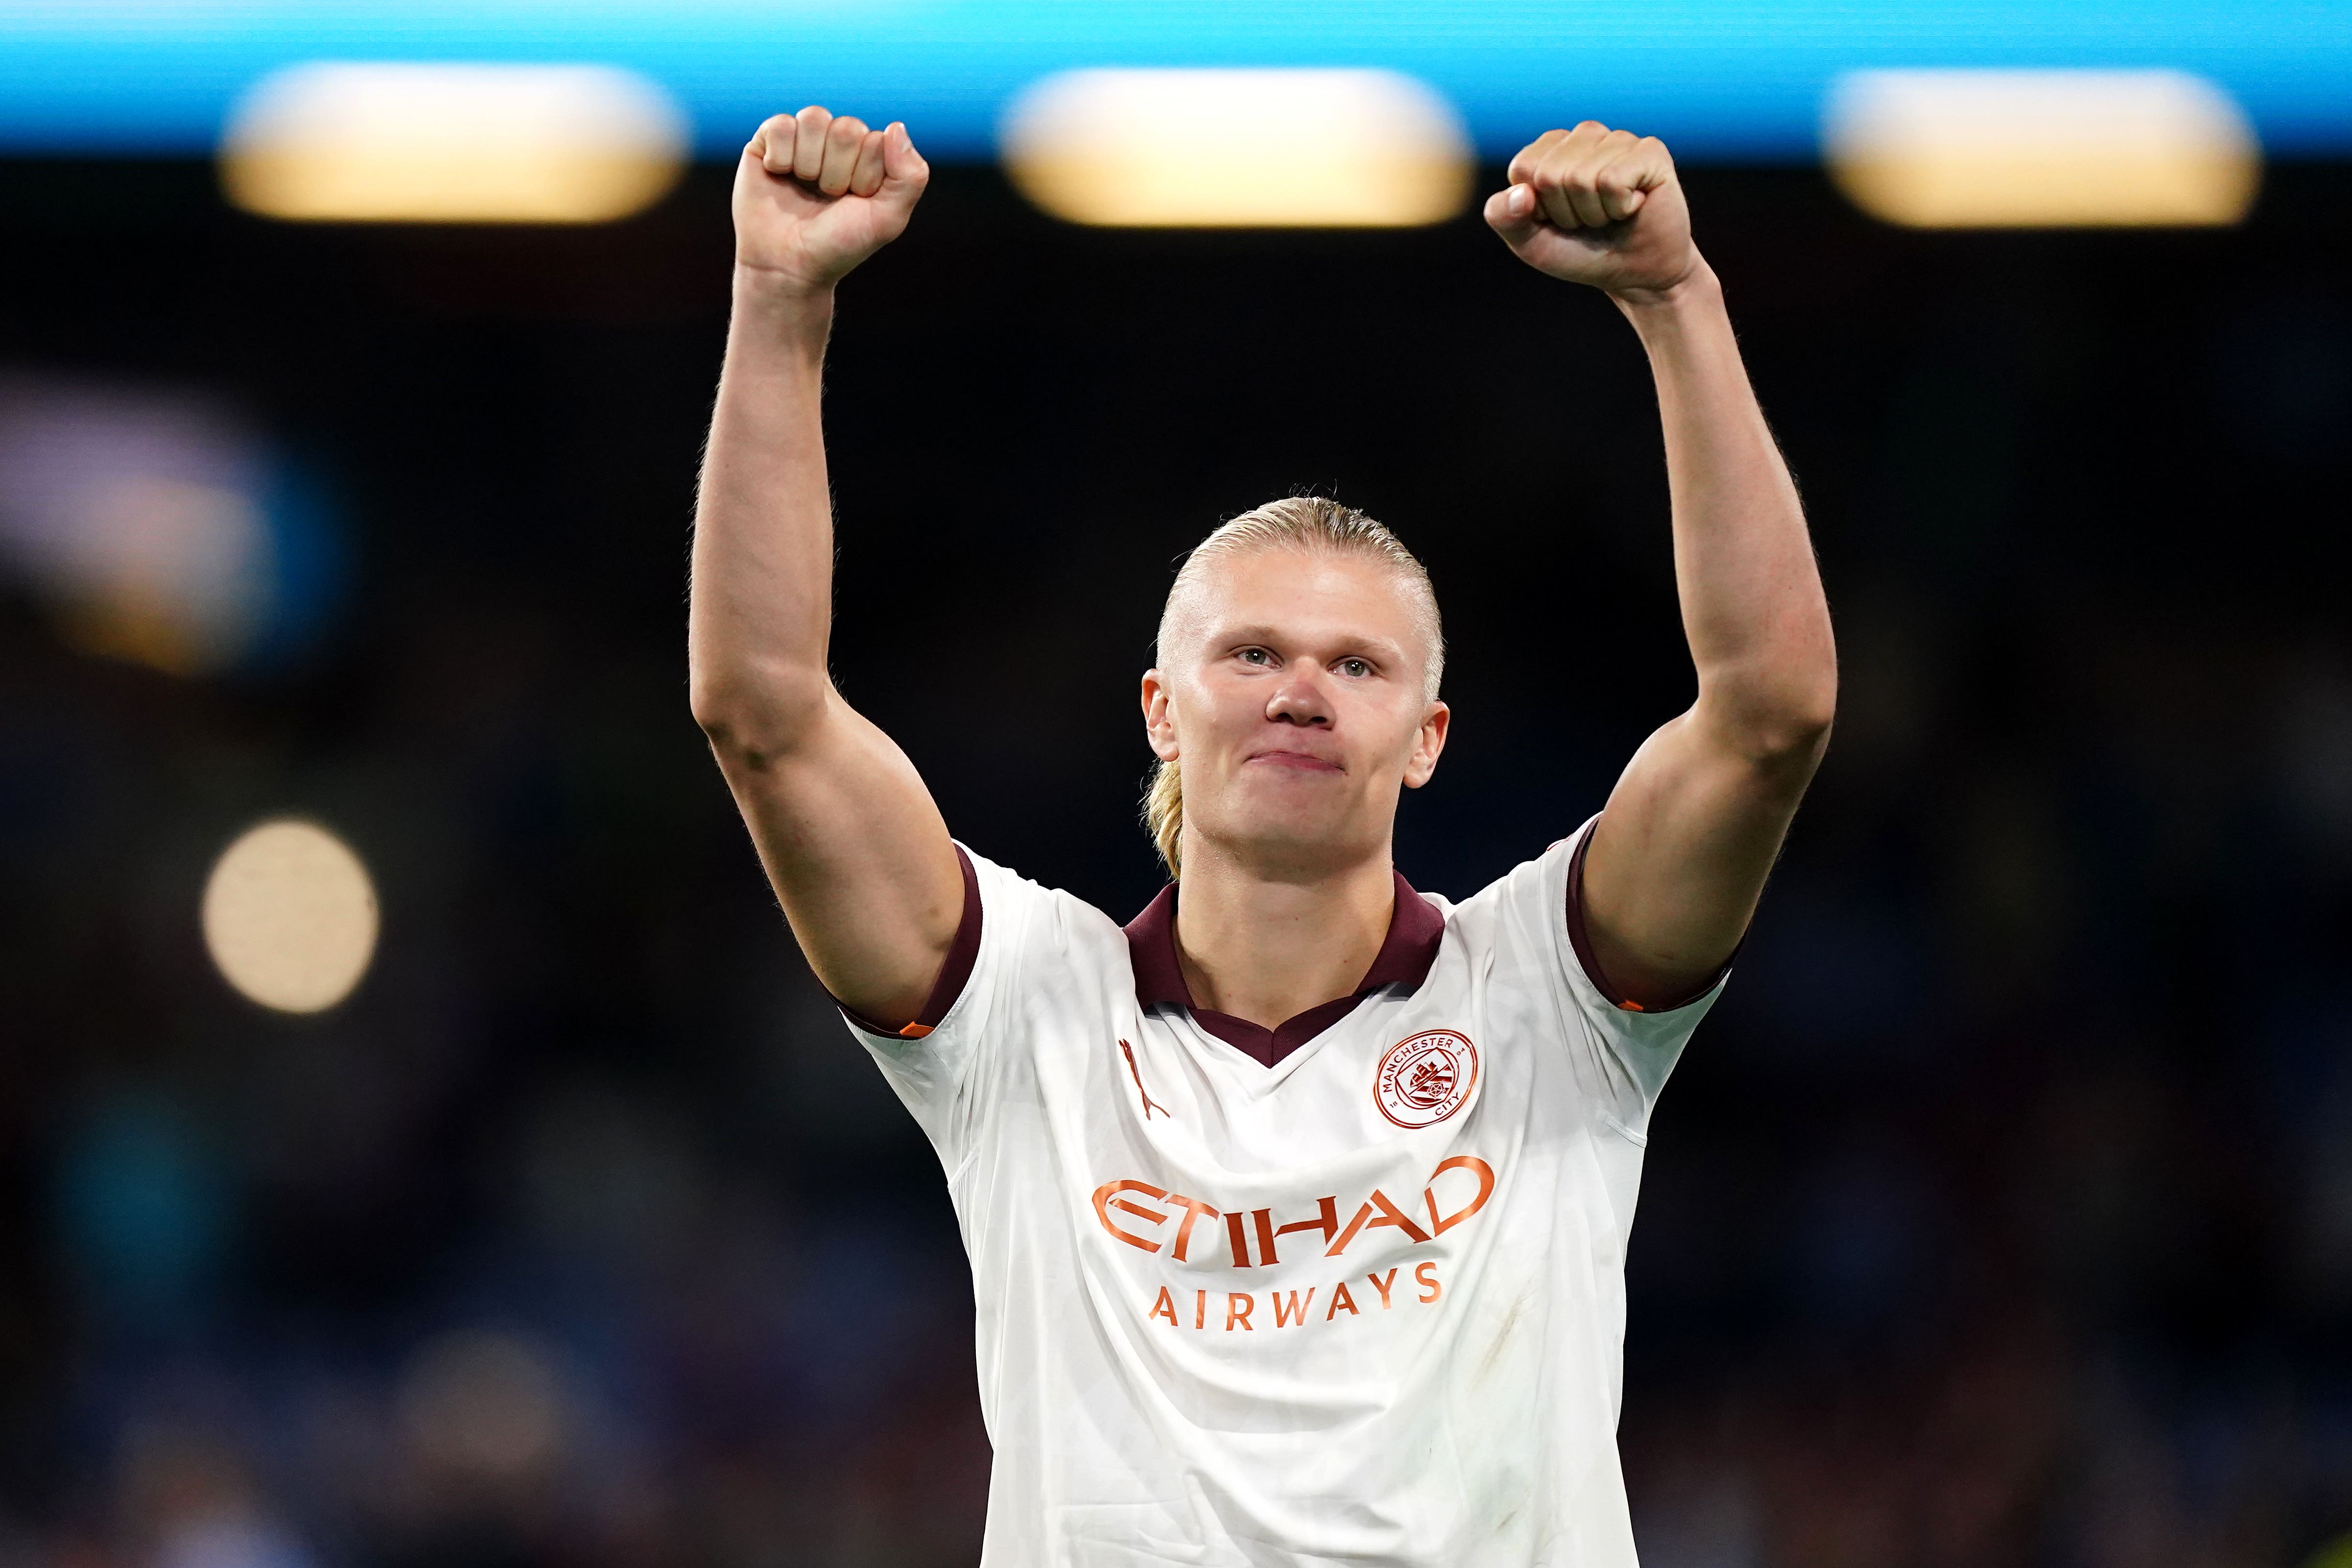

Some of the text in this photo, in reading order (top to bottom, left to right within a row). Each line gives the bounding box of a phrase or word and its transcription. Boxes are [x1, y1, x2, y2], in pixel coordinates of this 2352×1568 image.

[1383, 1038, 1453, 1092] MANCHESTER
[1435, 1092, 1459, 1116] CITY
[1092, 1155, 1495, 1268] ETIHAD
[1149, 1262, 1441, 1331] AIRWAYS
